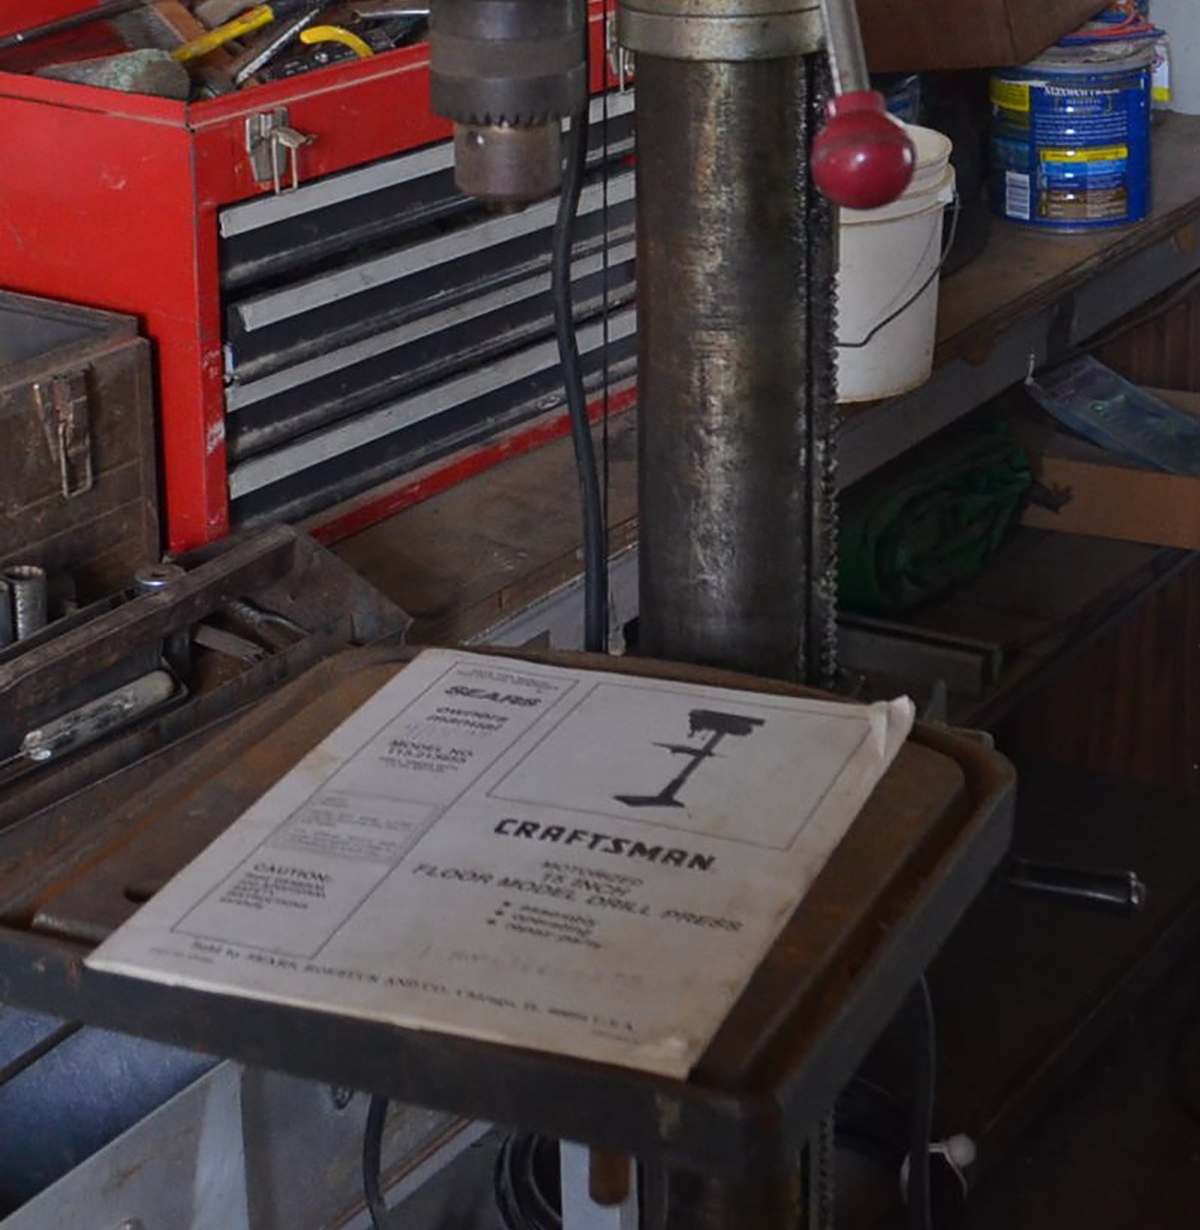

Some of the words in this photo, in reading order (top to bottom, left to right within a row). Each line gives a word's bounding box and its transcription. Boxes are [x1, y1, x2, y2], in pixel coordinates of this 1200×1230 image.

[444, 686, 542, 706] SEARS
[494, 818, 717, 871] CRAFTSMAN
[412, 863, 493, 885] FLOOR
[498, 877, 577, 902] MODEL
[586, 895, 651, 917] DRILL
[660, 908, 744, 933] PRESS
[572, 876, 632, 898] INCH
